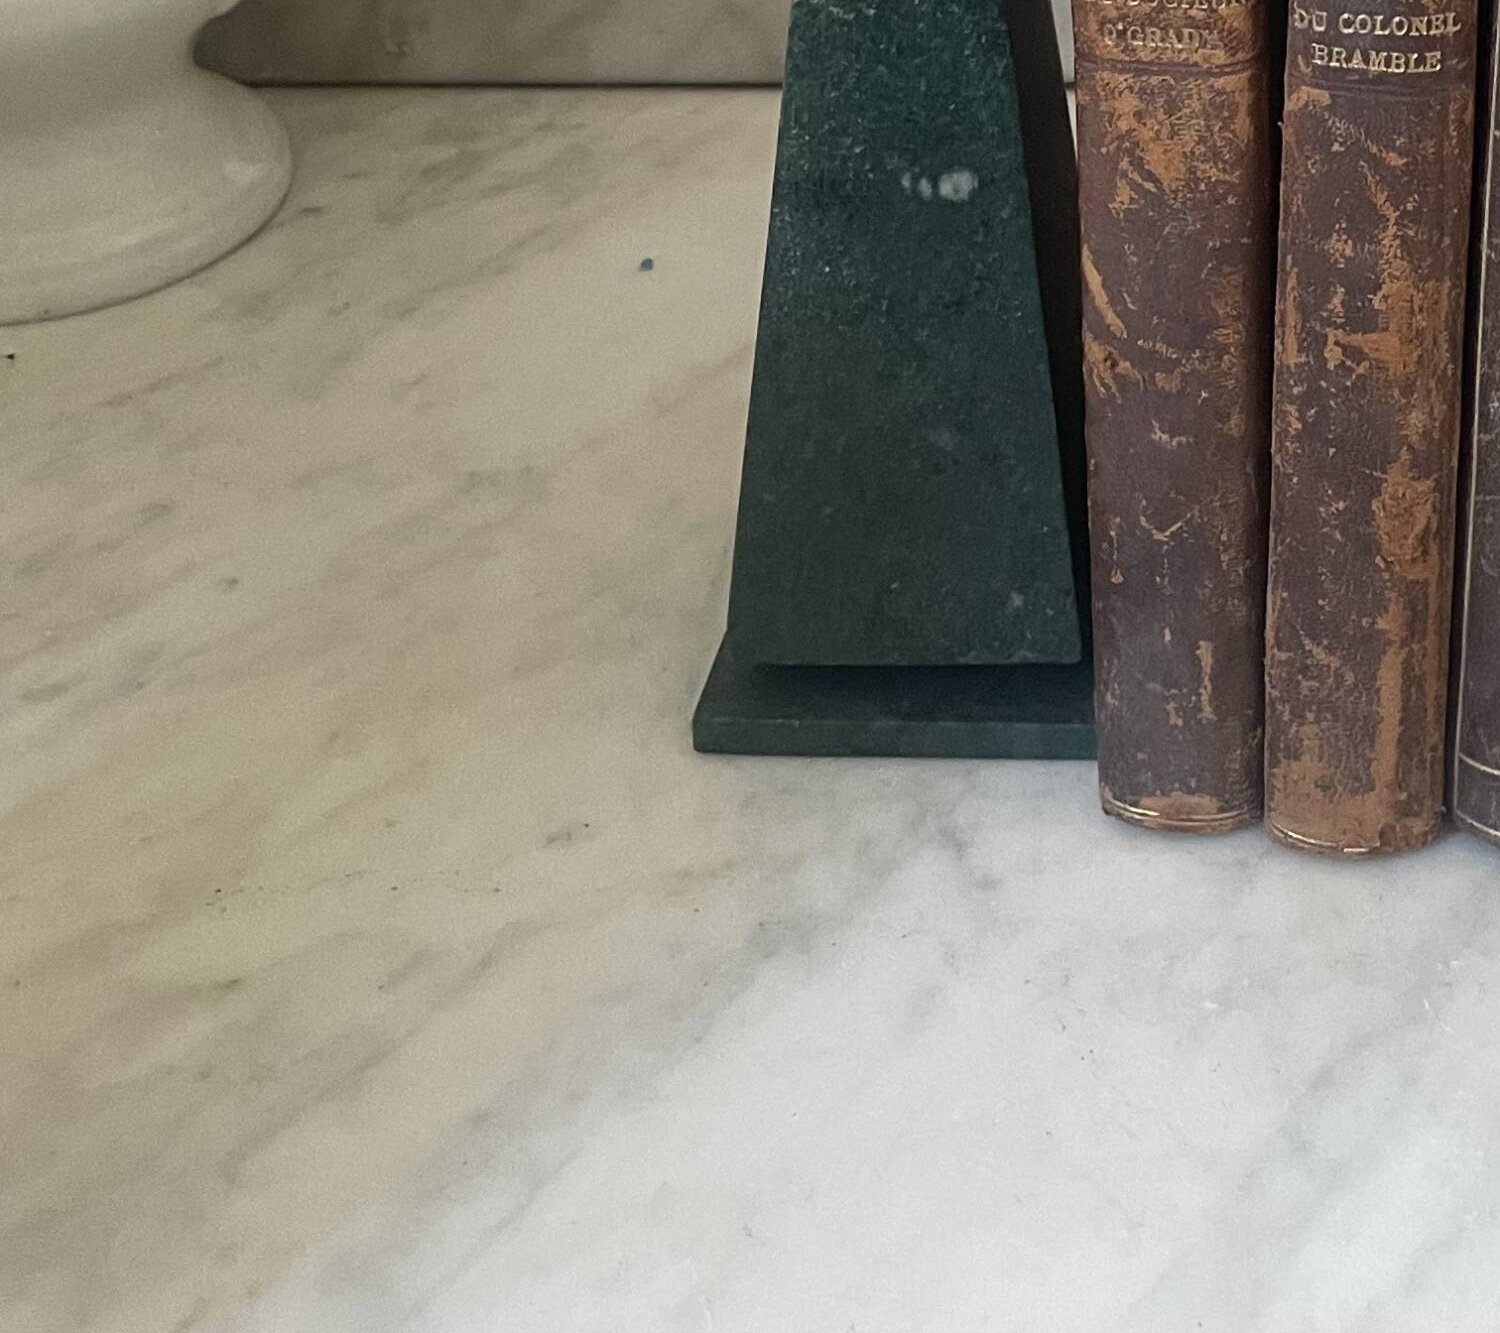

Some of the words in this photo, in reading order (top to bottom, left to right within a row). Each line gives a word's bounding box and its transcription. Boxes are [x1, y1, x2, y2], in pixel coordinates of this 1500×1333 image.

[1293, 5, 1328, 32] DU
[1338, 11, 1462, 37] COLONEL
[1311, 43, 1443, 74] BRAMBLE
